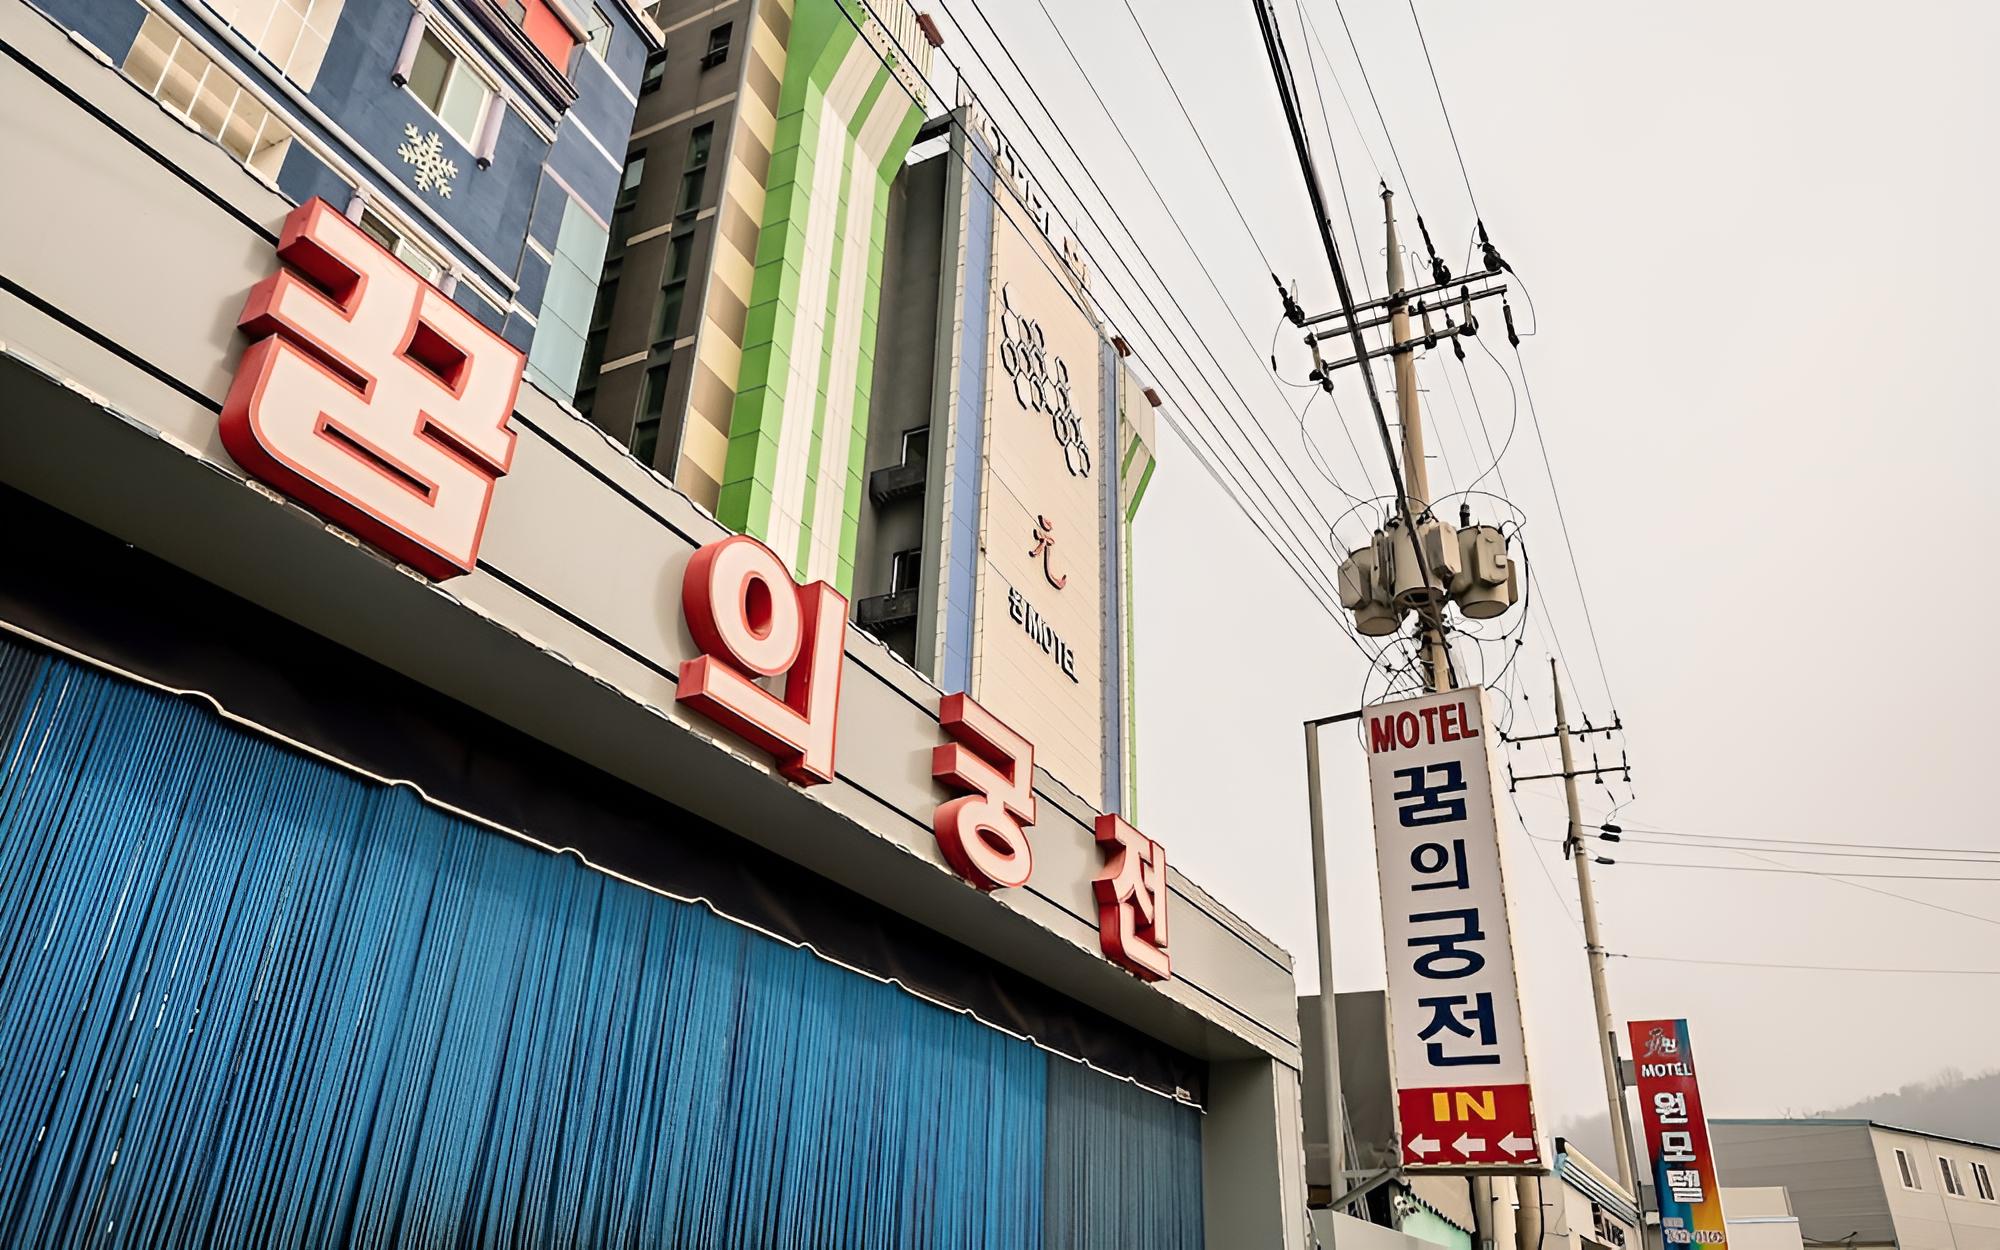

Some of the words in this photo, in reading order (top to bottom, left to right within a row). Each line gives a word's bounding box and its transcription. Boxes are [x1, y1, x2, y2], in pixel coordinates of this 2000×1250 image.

[1370, 702, 1479, 754] MOTEL
[1393, 761, 1501, 1067] 꿈의궁전
[1641, 1062, 1692, 1077] MOTEL
[1432, 1090, 1496, 1122] IN
[1654, 1092, 1704, 1202] 원모텔
